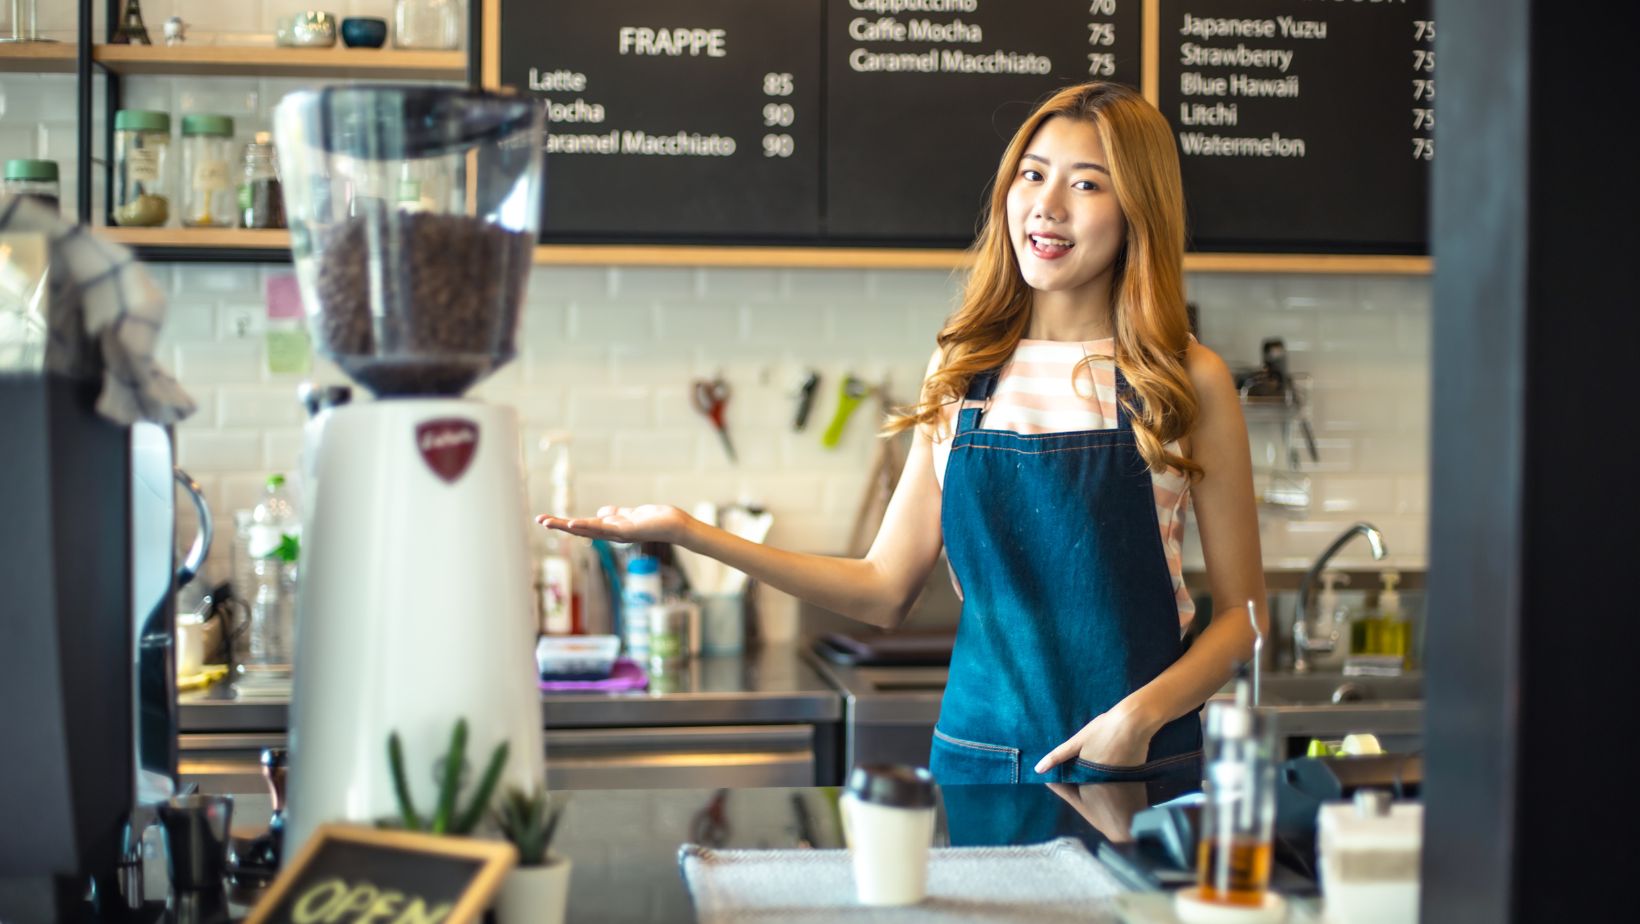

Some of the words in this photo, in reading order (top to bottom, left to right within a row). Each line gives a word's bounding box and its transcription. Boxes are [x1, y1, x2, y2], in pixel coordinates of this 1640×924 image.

[1089, 0, 1116, 15] 70
[619, 27, 727, 57] FRAPPE
[849, 17, 907, 41] Caffe
[908, 18, 982, 42] Mocha
[1088, 23, 1115, 46] 75
[1180, 14, 1275, 40] Japanese
[1276, 16, 1327, 39] Yuzu
[1413, 20, 1435, 41] 75
[849, 48, 939, 72] Caramel
[941, 50, 1051, 74] Macchiato
[1088, 53, 1115, 76] 75
[1181, 43, 1294, 72] Strawberry
[1413, 50, 1435, 72] 75
[529, 67, 587, 91] Latte
[763, 73, 794, 96] 85
[1180, 72, 1227, 96] Blue
[1229, 74, 1299, 98] Hawaii
[1412, 79, 1435, 101] 75
[763, 103, 794, 126] 90
[1180, 102, 1238, 126] Litchi
[1412, 108, 1435, 131] 75
[546, 129, 619, 154] aramel
[622, 130, 736, 156] Macchiato
[763, 133, 794, 157] 90
[1180, 132, 1305, 157] Watermelon
[1412, 137, 1434, 160] 75
[292, 879, 452, 924] OPEN
